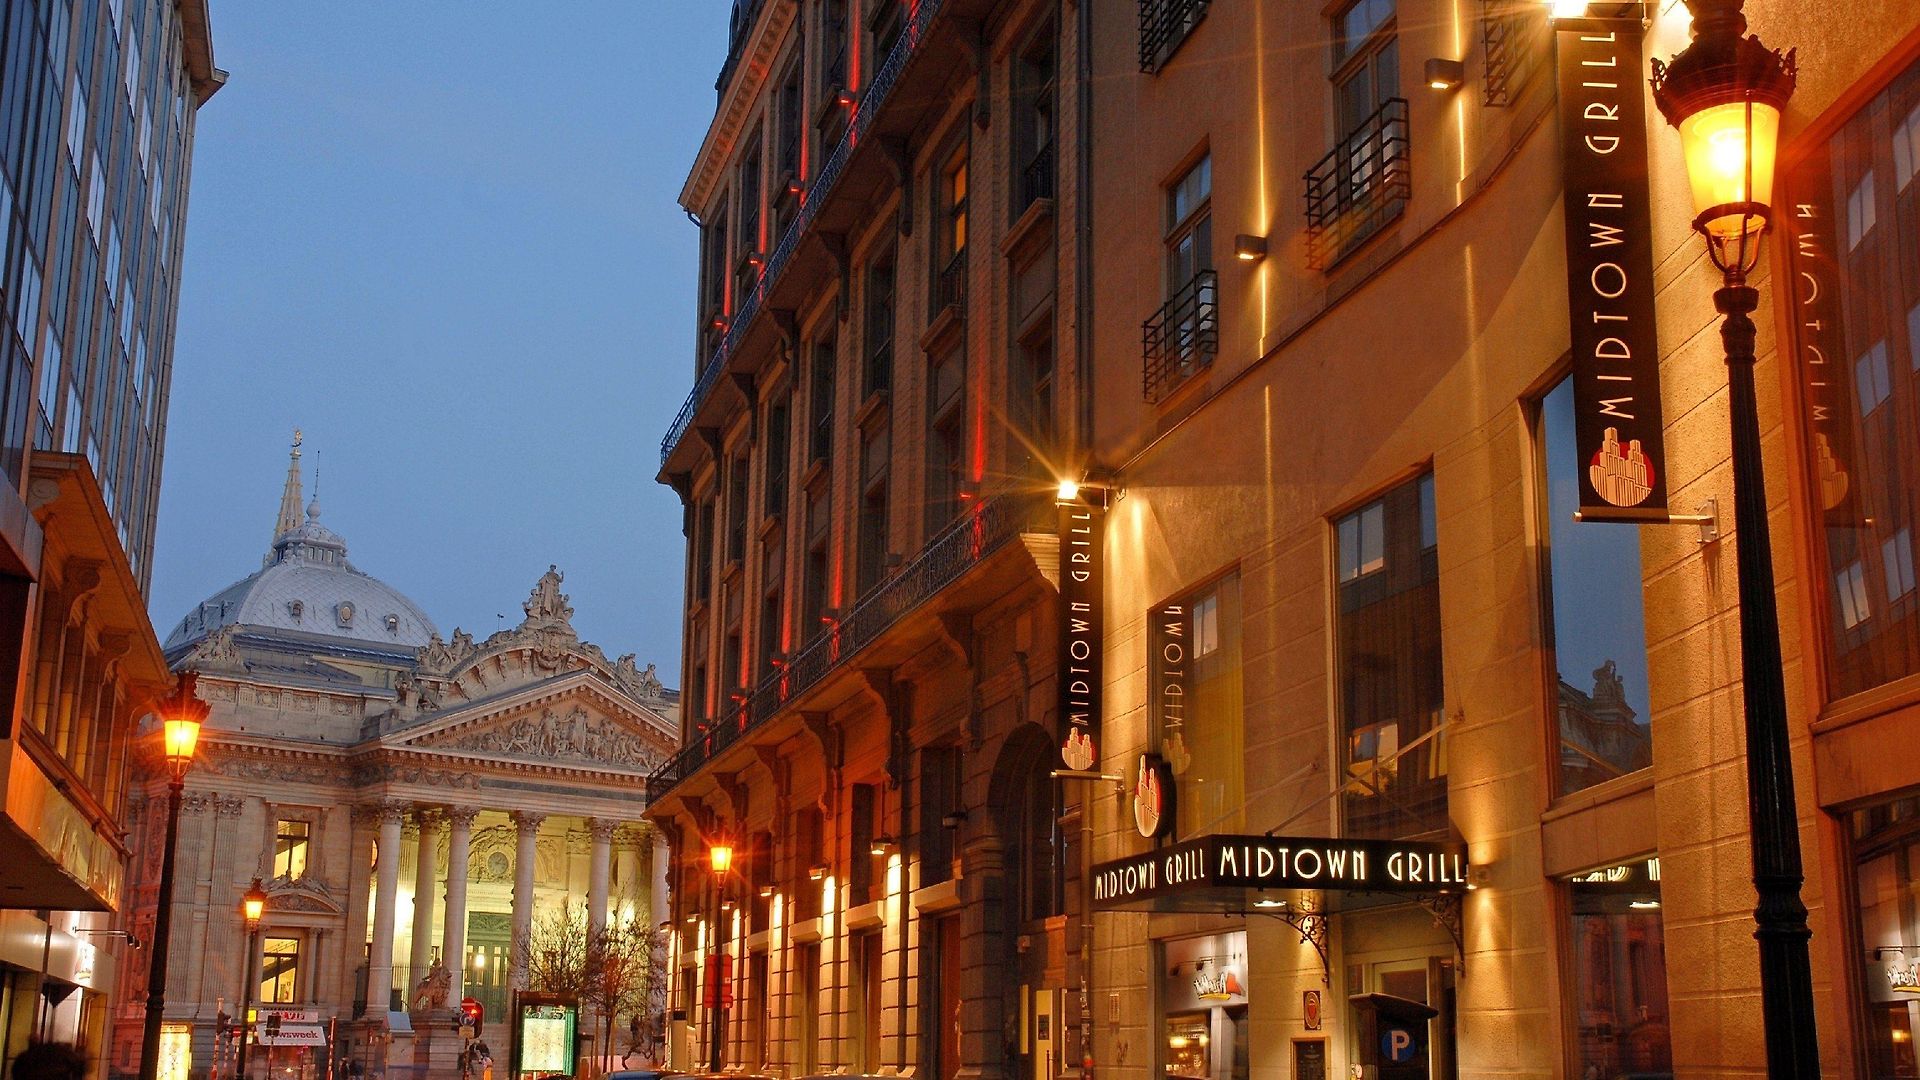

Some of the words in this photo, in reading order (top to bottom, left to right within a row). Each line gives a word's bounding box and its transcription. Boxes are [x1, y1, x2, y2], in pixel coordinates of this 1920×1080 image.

[1580, 31, 1620, 155] GRILL
[1587, 193, 1635, 420] MIDTOWN
[1071, 513, 1091, 582] GRILL
[1070, 602, 1090, 726] MIDTOWN
[1094, 860, 1156, 900] MIDTOWN
[1165, 848, 1205, 885] GRILL
[1219, 846, 1366, 881] MIDTOWN
[1386, 851, 1465, 884] GRILL
[1391, 1030, 1410, 1060] P
